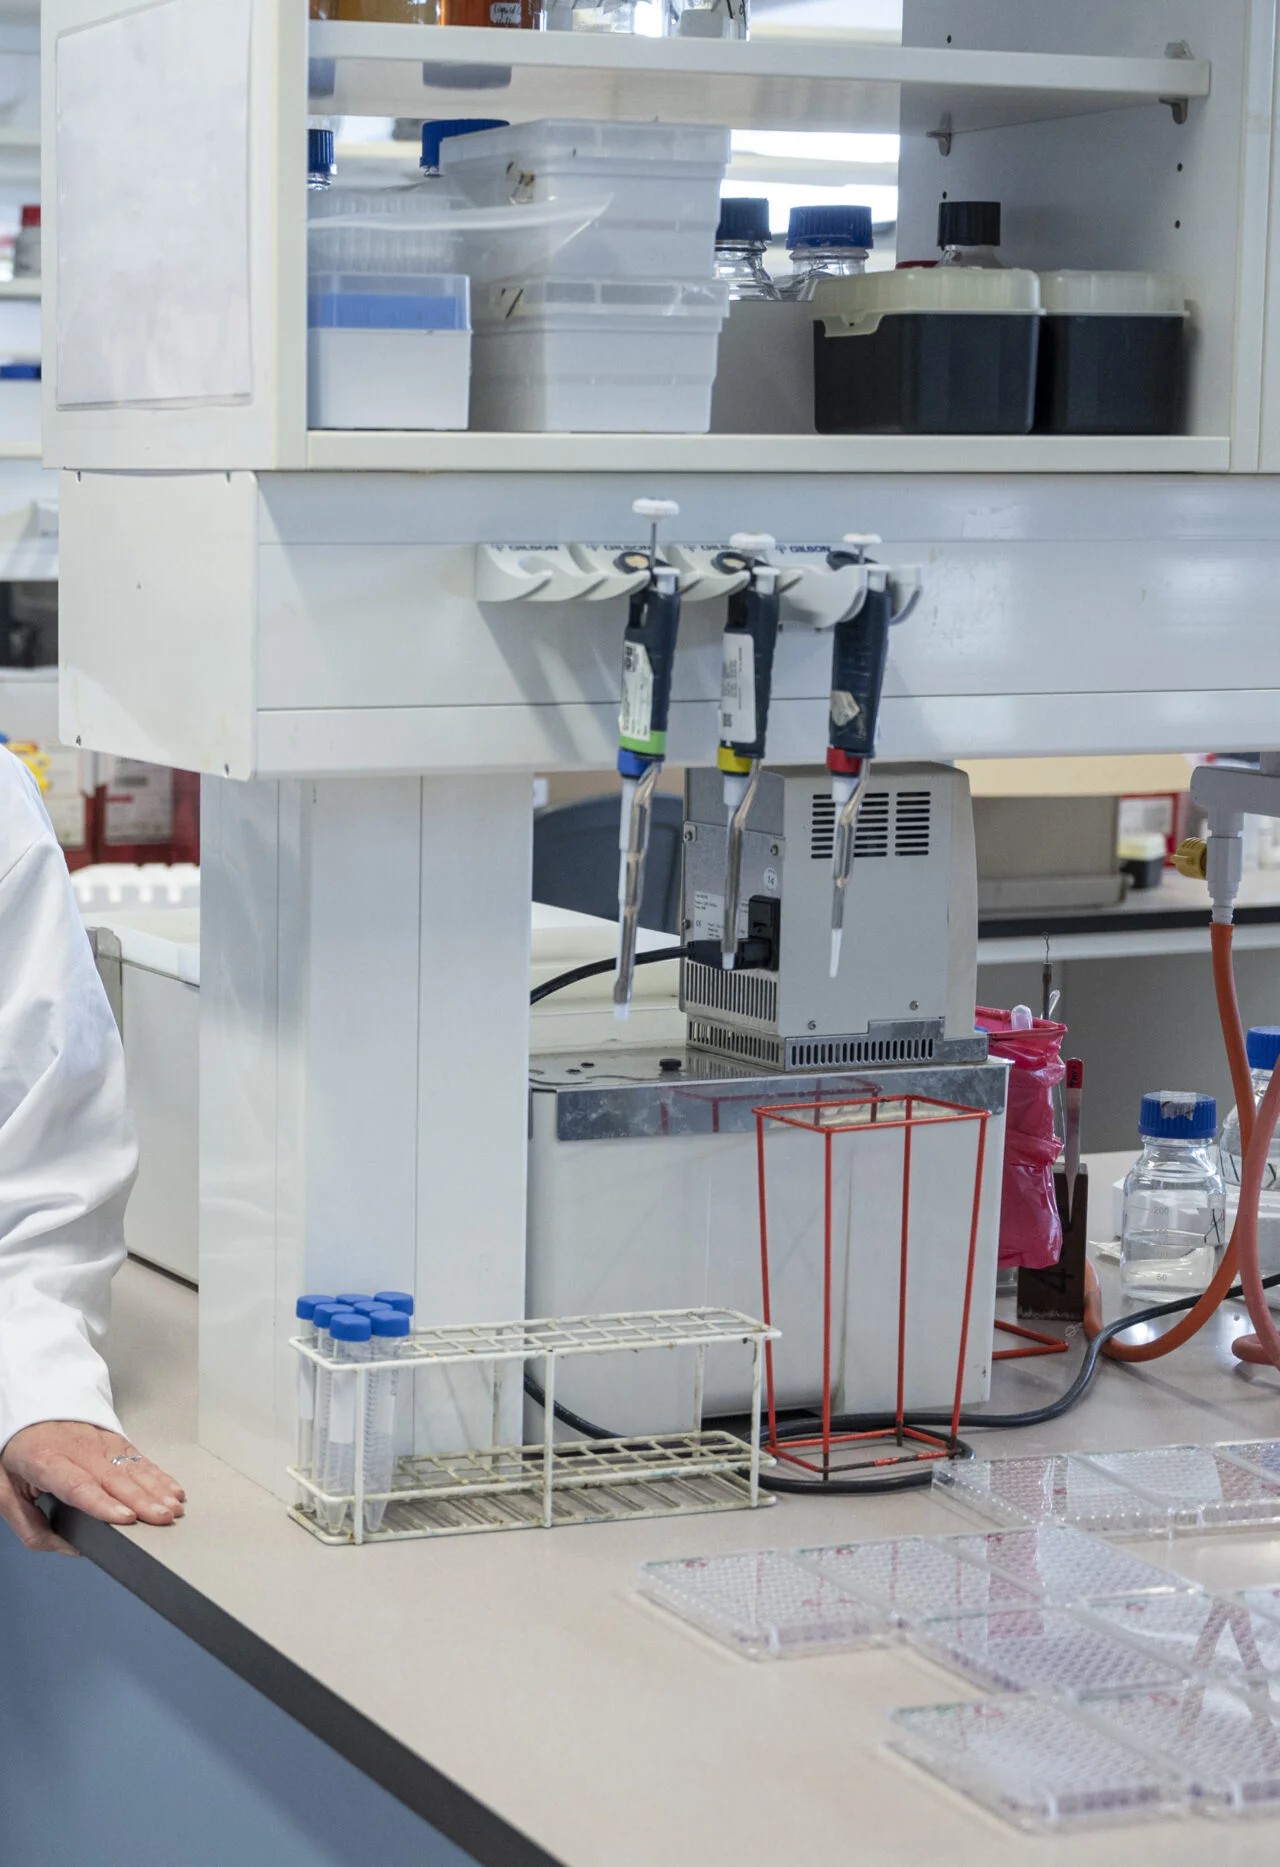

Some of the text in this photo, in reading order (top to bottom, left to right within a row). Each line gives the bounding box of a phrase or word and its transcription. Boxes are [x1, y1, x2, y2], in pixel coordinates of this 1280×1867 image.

[789, 544, 832, 553] GILSON
[1153, 1206, 1169, 1216] 200
[1156, 1273, 1168, 1282] 50
